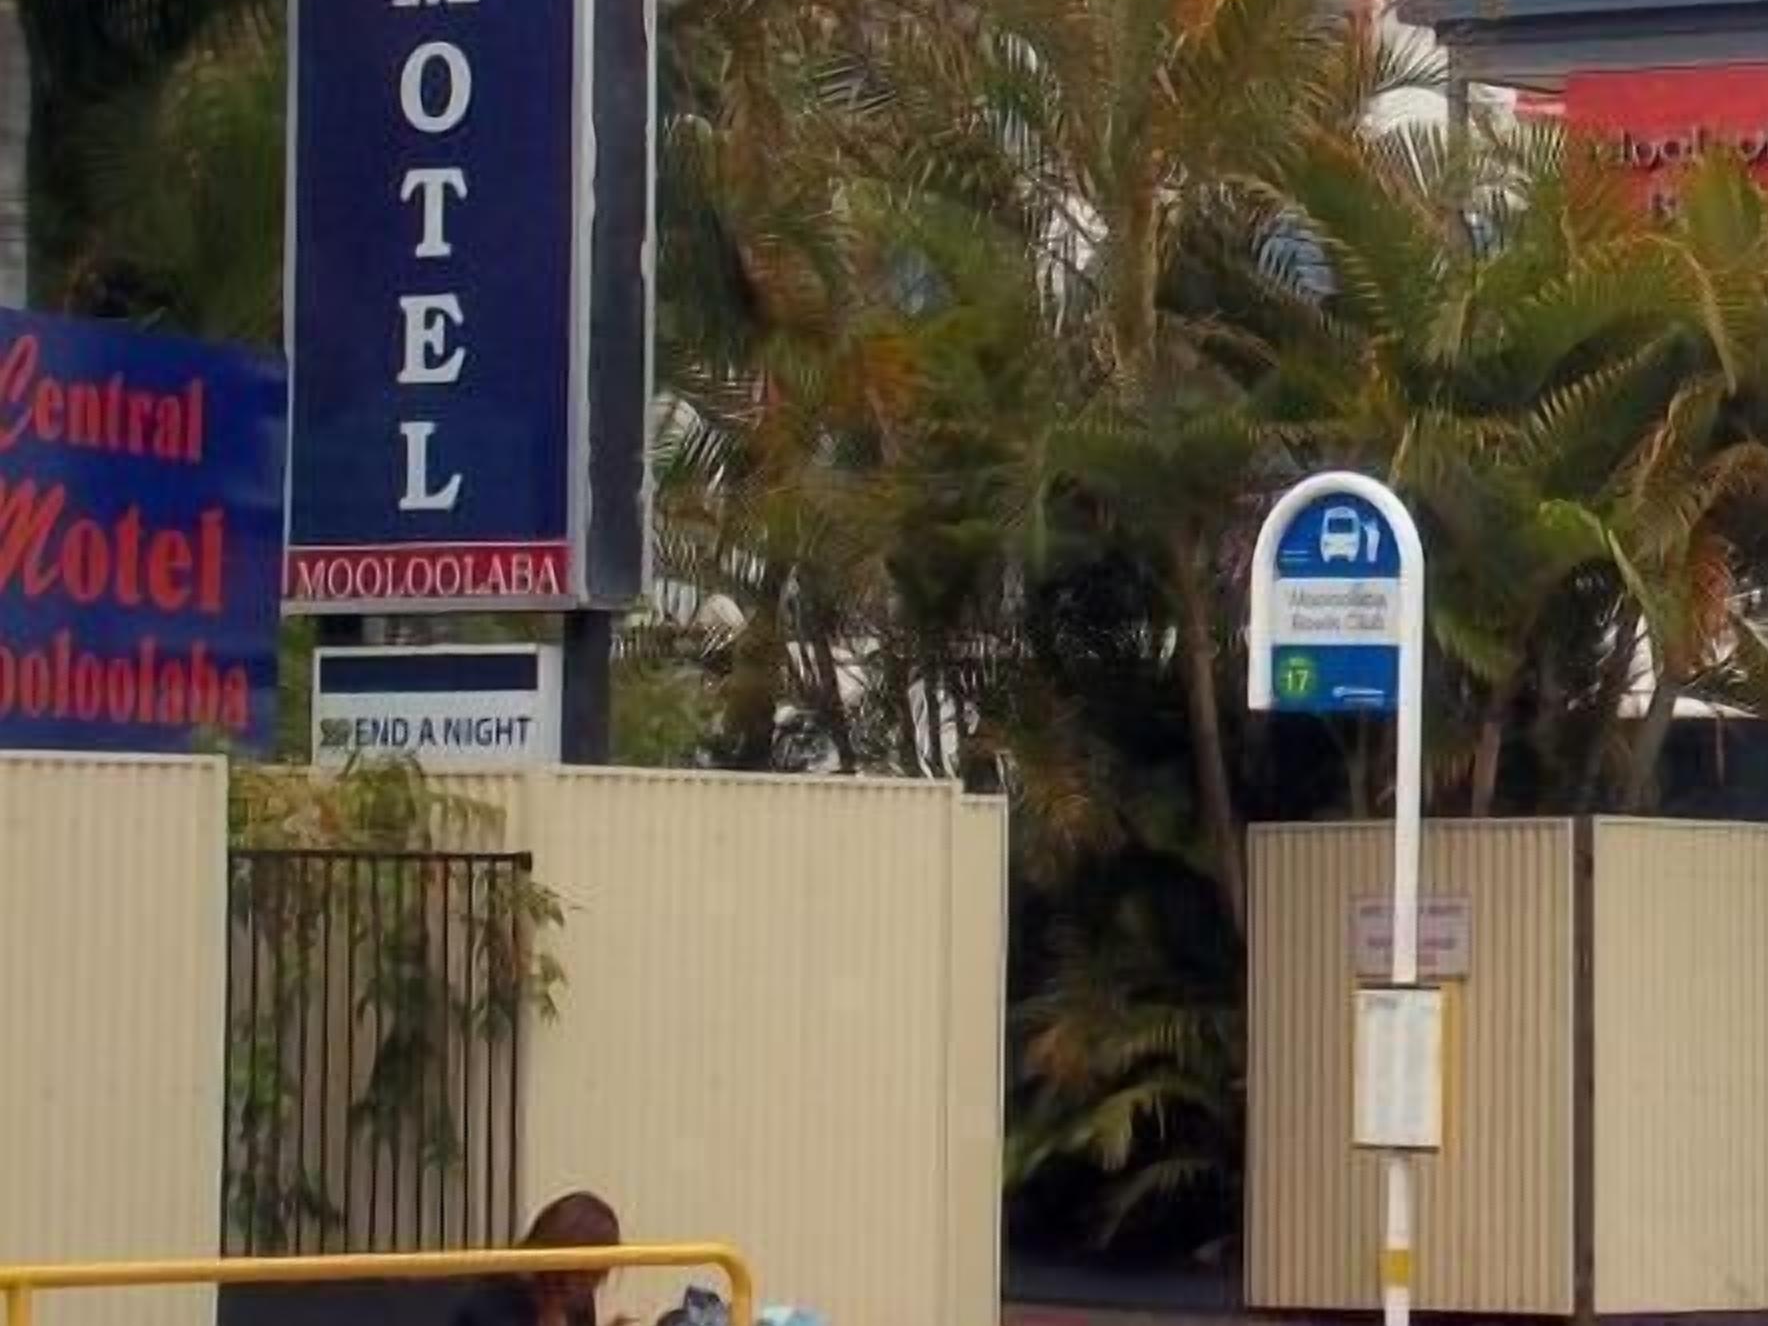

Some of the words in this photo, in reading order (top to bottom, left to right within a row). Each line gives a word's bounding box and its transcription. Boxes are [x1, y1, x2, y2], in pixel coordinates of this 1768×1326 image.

[0, 477, 226, 614] Motel
[296, 552, 562, 600] MOOLOOLABA
[418, 716, 437, 747] A
[444, 716, 531, 747] NIGHT
